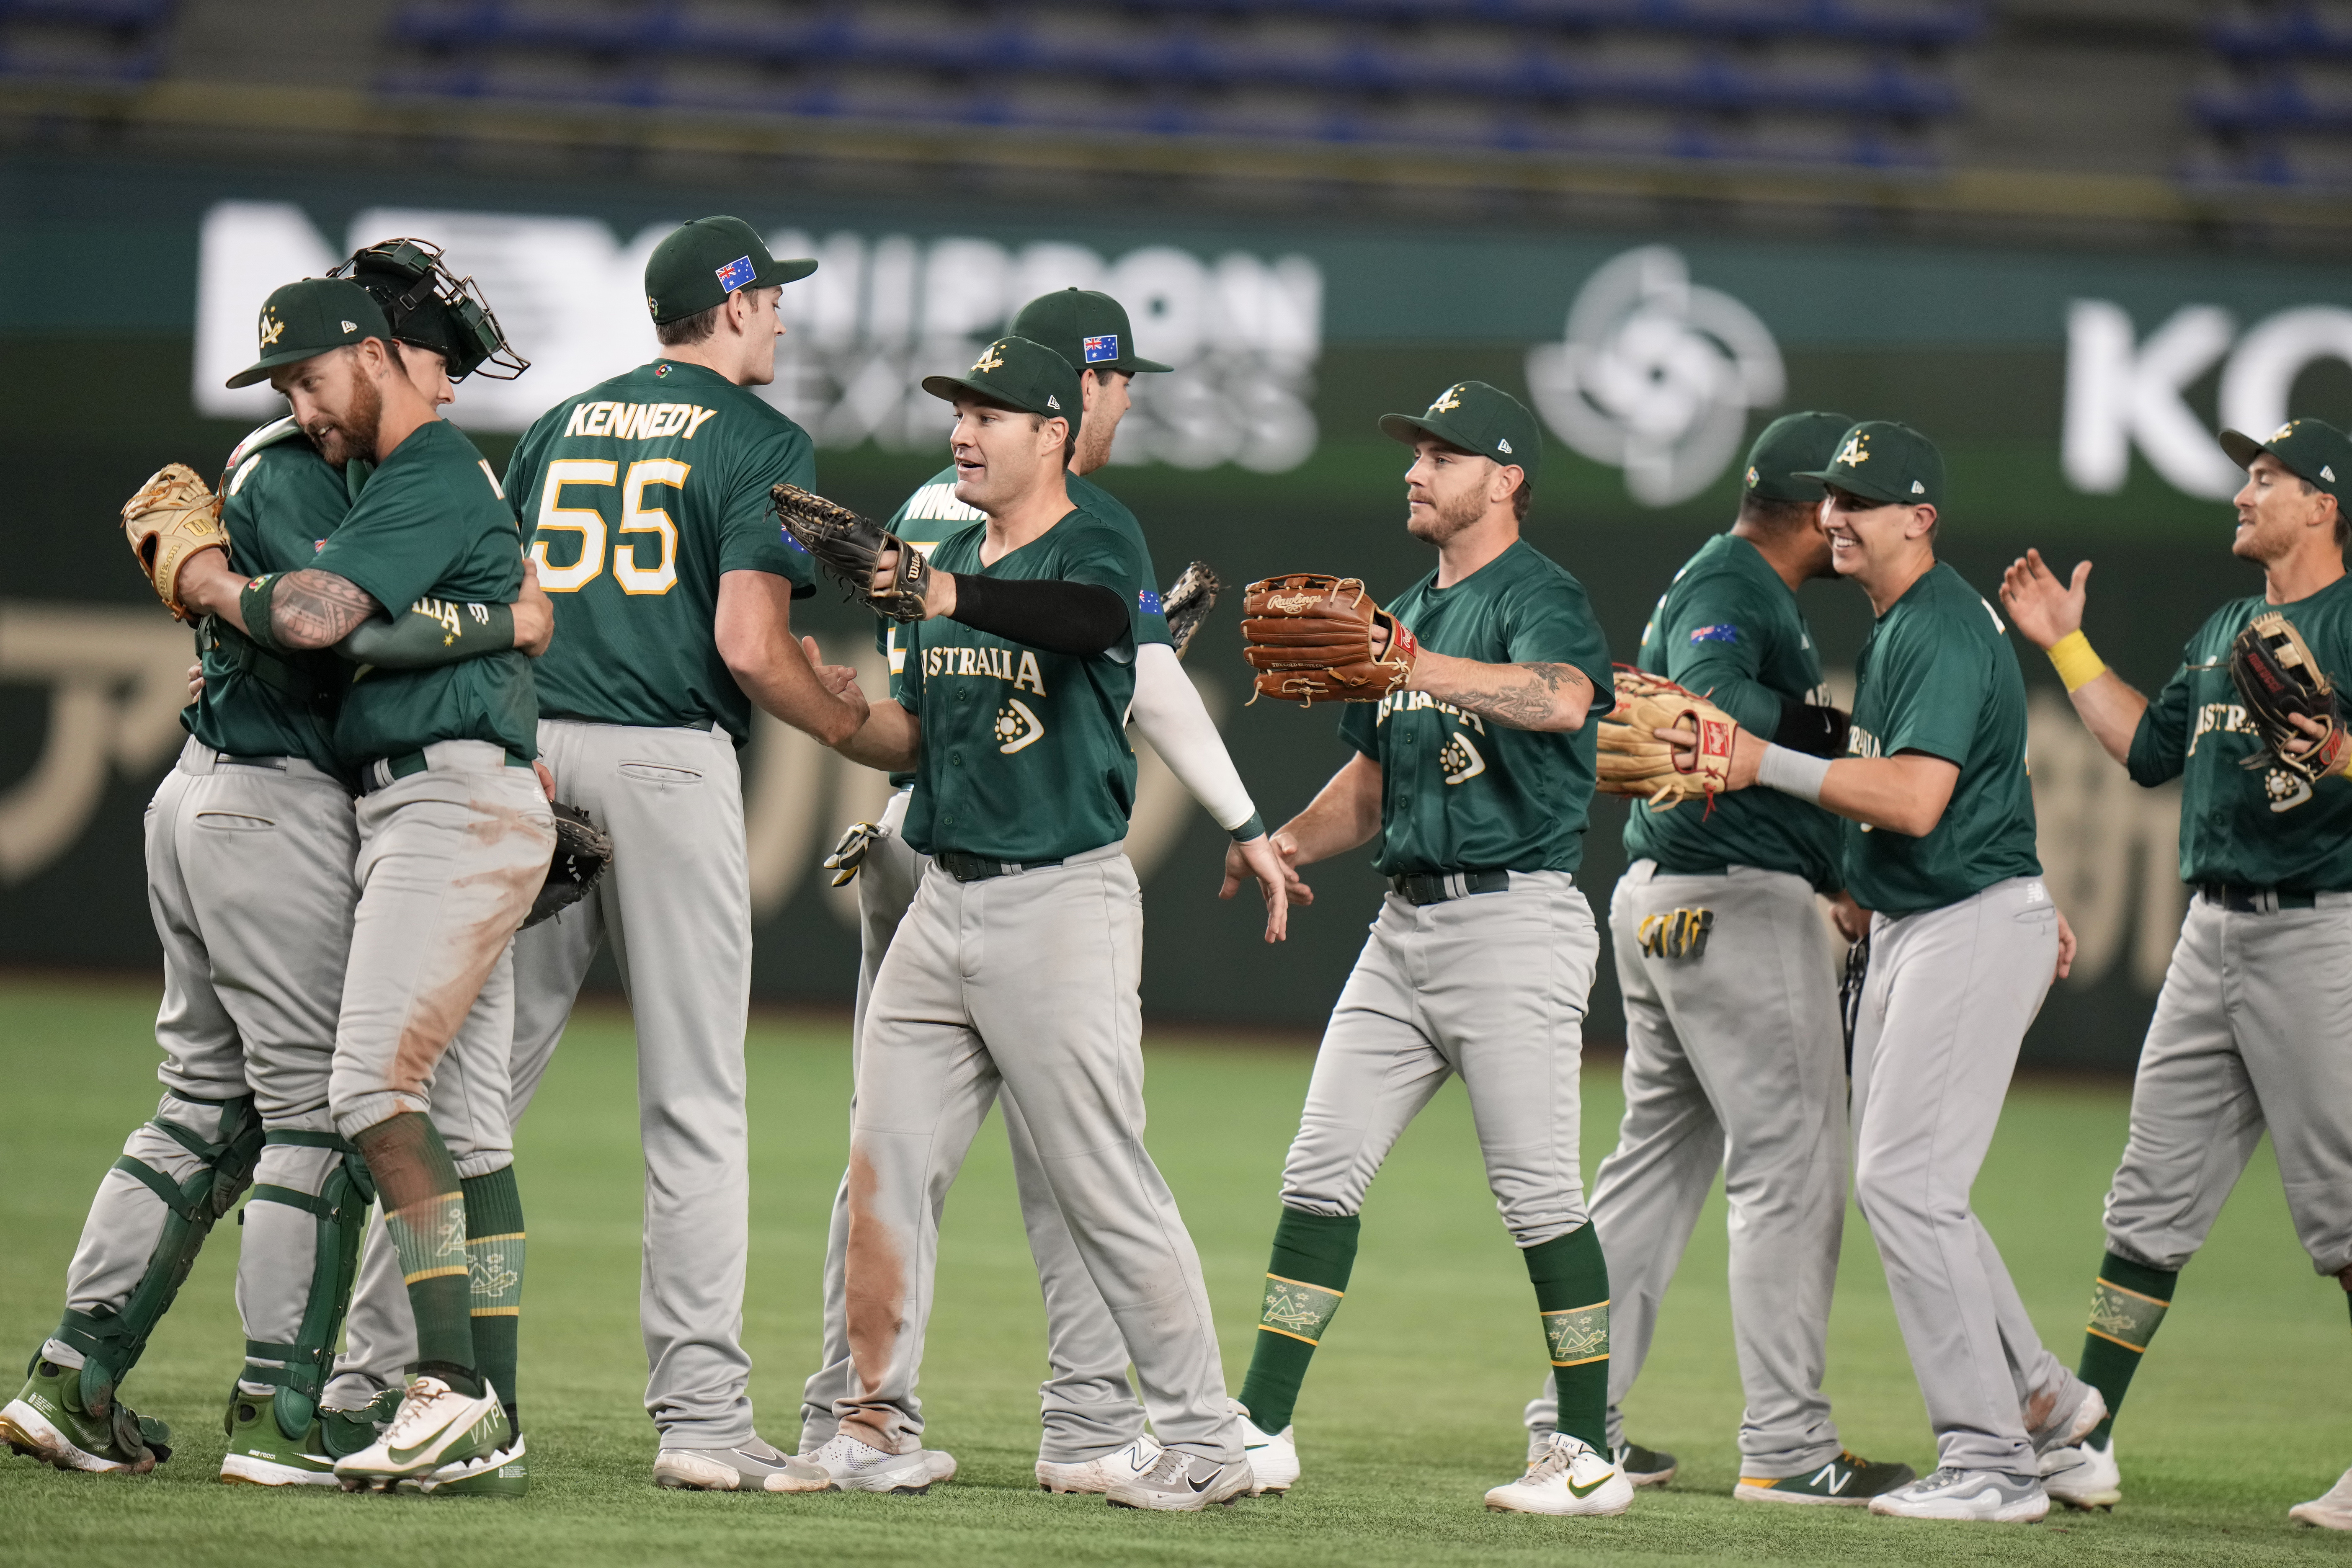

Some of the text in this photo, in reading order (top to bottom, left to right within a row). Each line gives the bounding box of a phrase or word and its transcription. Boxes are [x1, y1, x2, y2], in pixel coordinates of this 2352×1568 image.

[564, 402, 717, 440] KENNEDY
[529, 457, 692, 595] 55
[158, 544, 180, 593] Wilson
[1267, 593, 1323, 610] Rawlings
